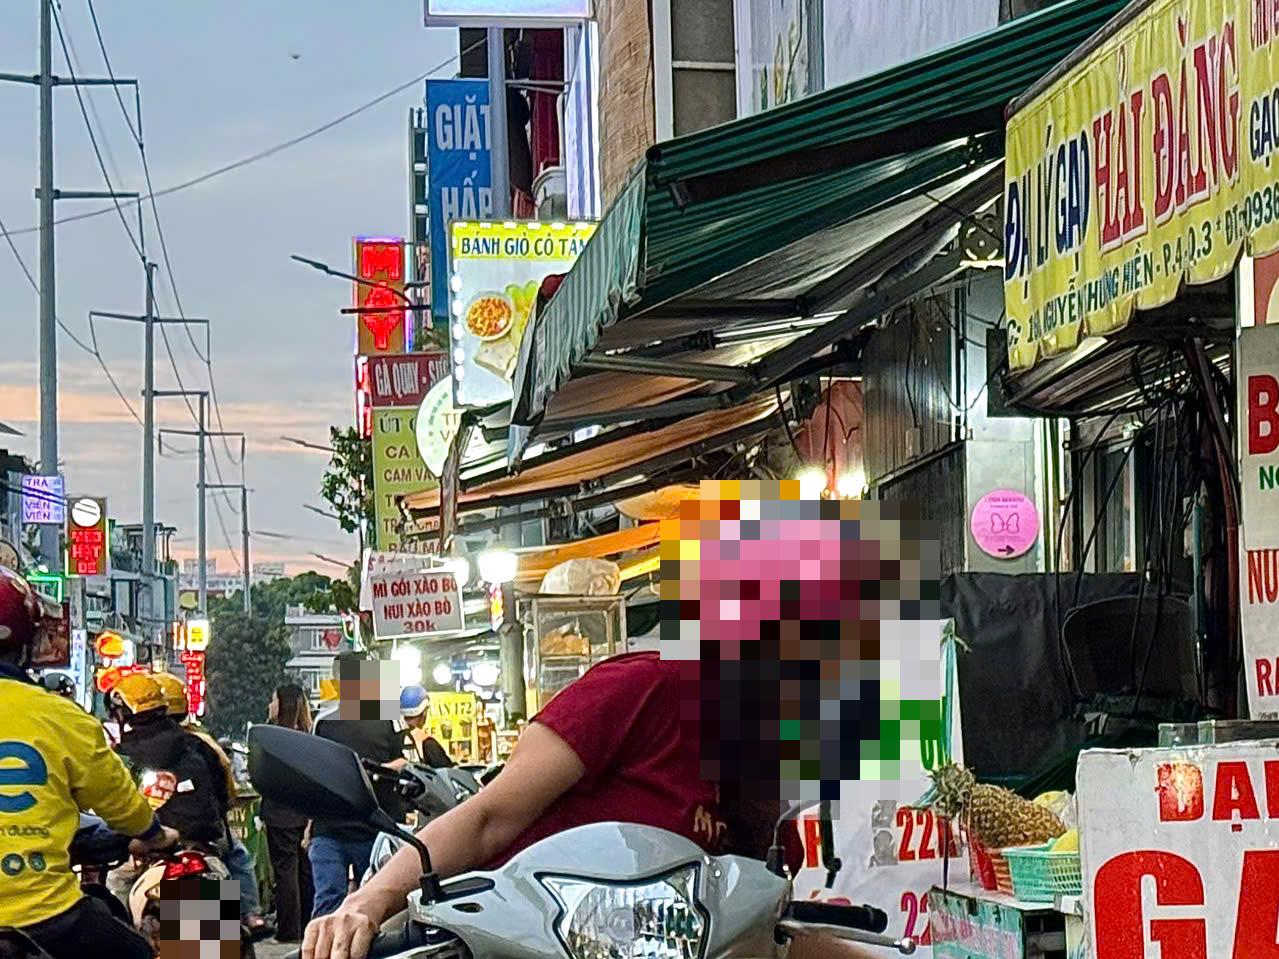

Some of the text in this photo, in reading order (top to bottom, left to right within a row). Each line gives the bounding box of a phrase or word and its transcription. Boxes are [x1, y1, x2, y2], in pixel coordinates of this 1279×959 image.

[1093, 44, 1146, 250] HẢI
[1152, 14, 1240, 222] ĐĂNG
[461, 231, 500, 256] BÁNH
